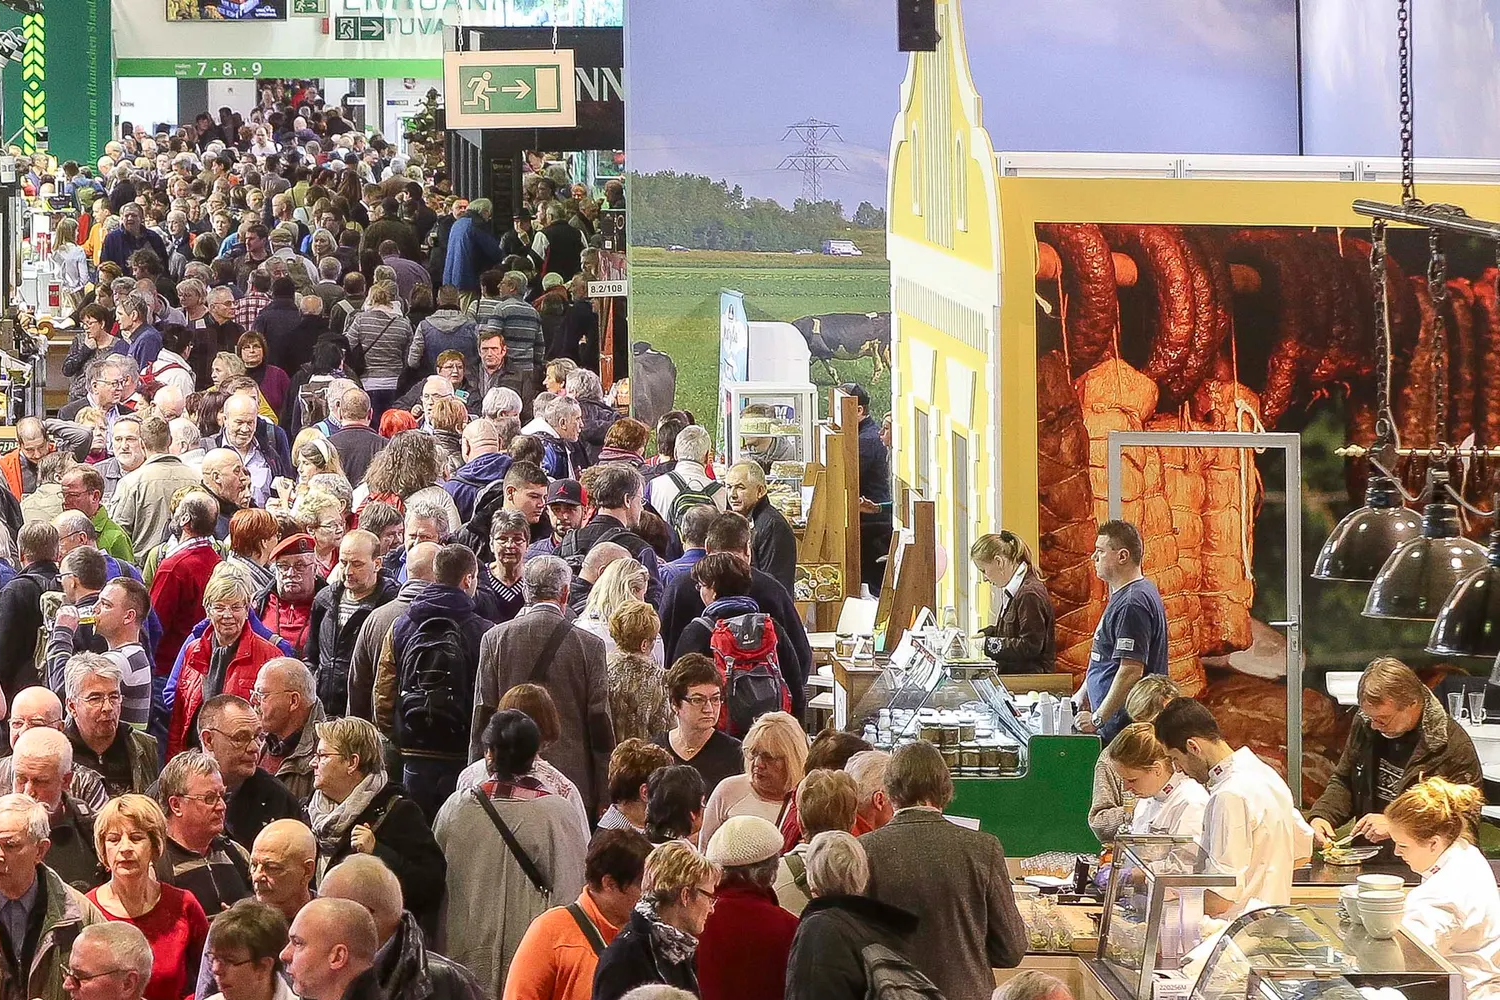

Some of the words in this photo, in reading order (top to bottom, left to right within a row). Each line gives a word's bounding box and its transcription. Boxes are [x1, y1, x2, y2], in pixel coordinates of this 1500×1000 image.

[385, 17, 443, 35] TUVA
[197, 62, 207, 76] 7
[251, 62, 262, 76] 9
[590, 284, 623, 294] 8.2/108
